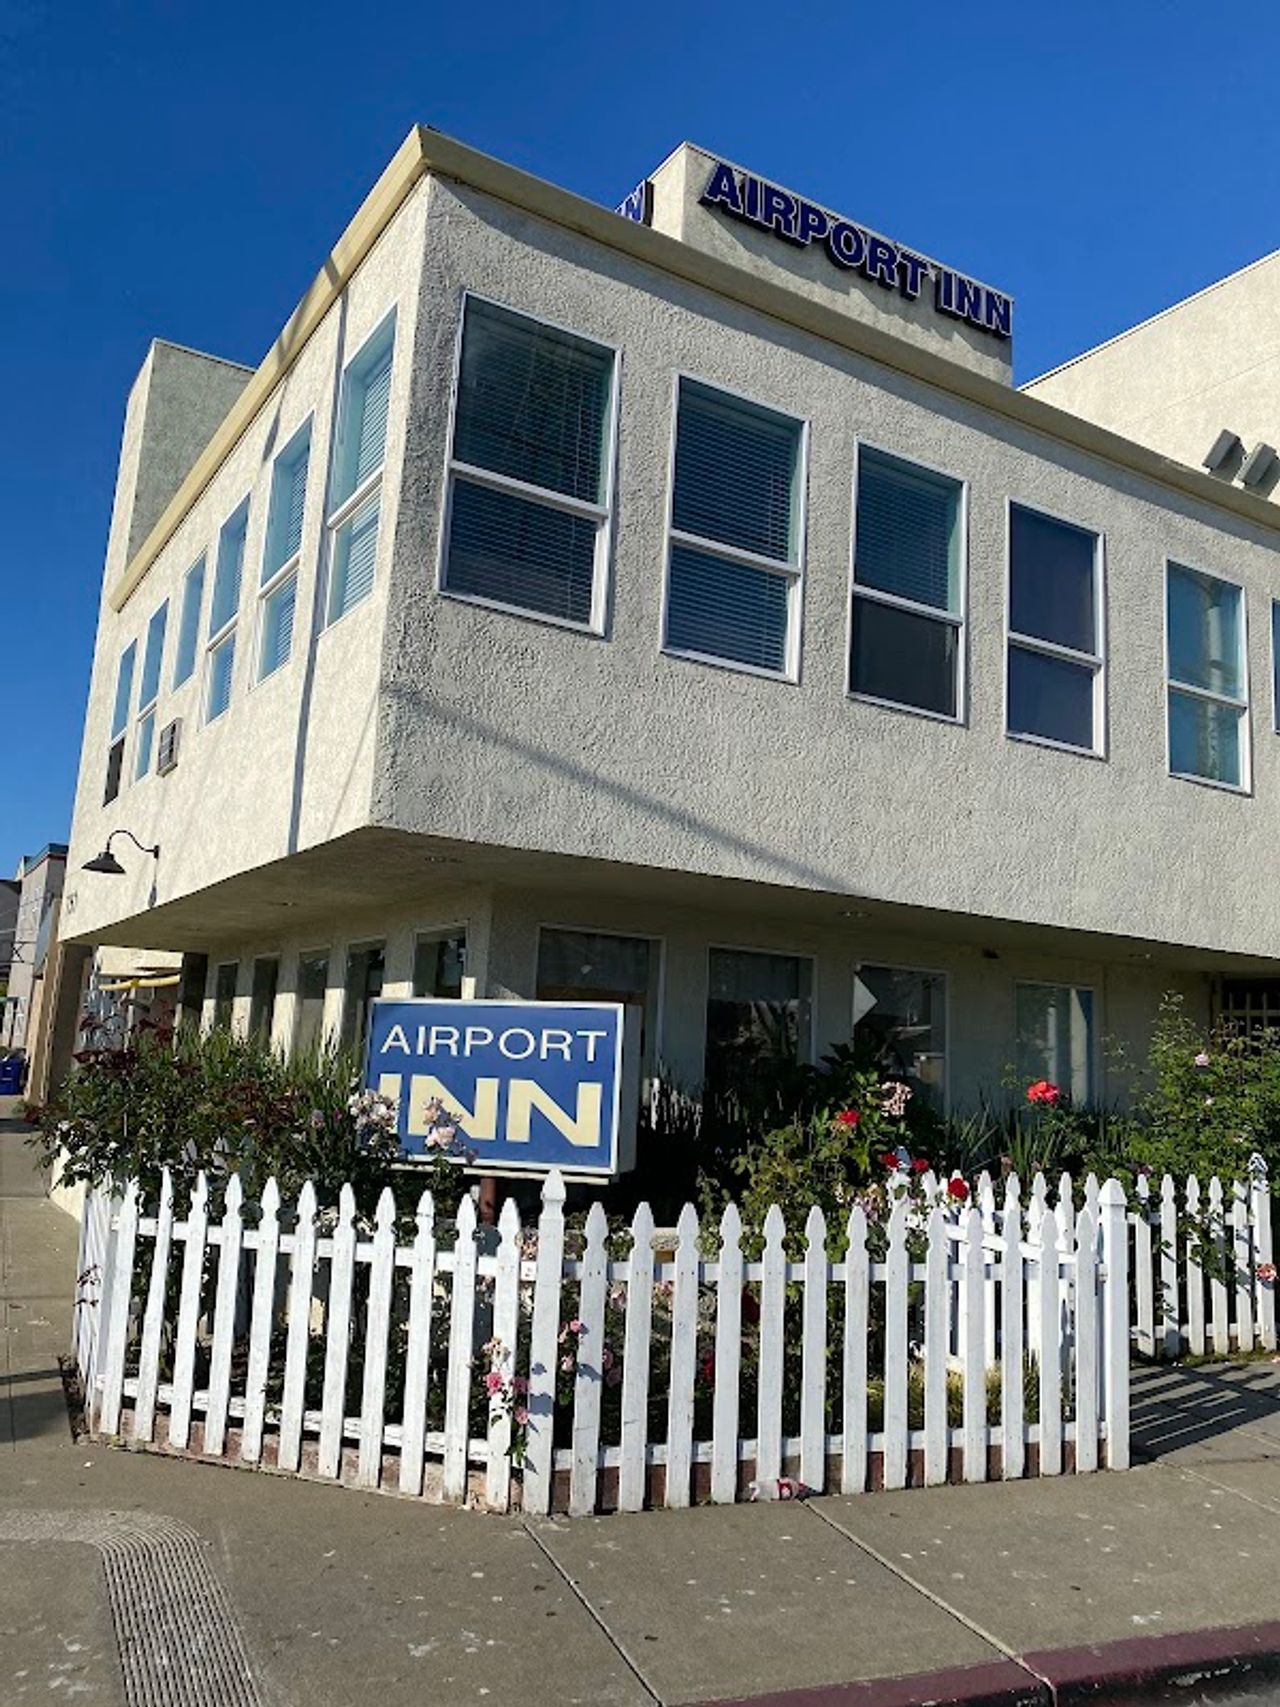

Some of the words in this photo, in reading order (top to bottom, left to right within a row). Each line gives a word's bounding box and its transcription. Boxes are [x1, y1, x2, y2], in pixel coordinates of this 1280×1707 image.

[702, 163, 928, 297] AIRPORT
[939, 270, 1012, 337] INN
[380, 1024, 607, 1062] AIRPORT
